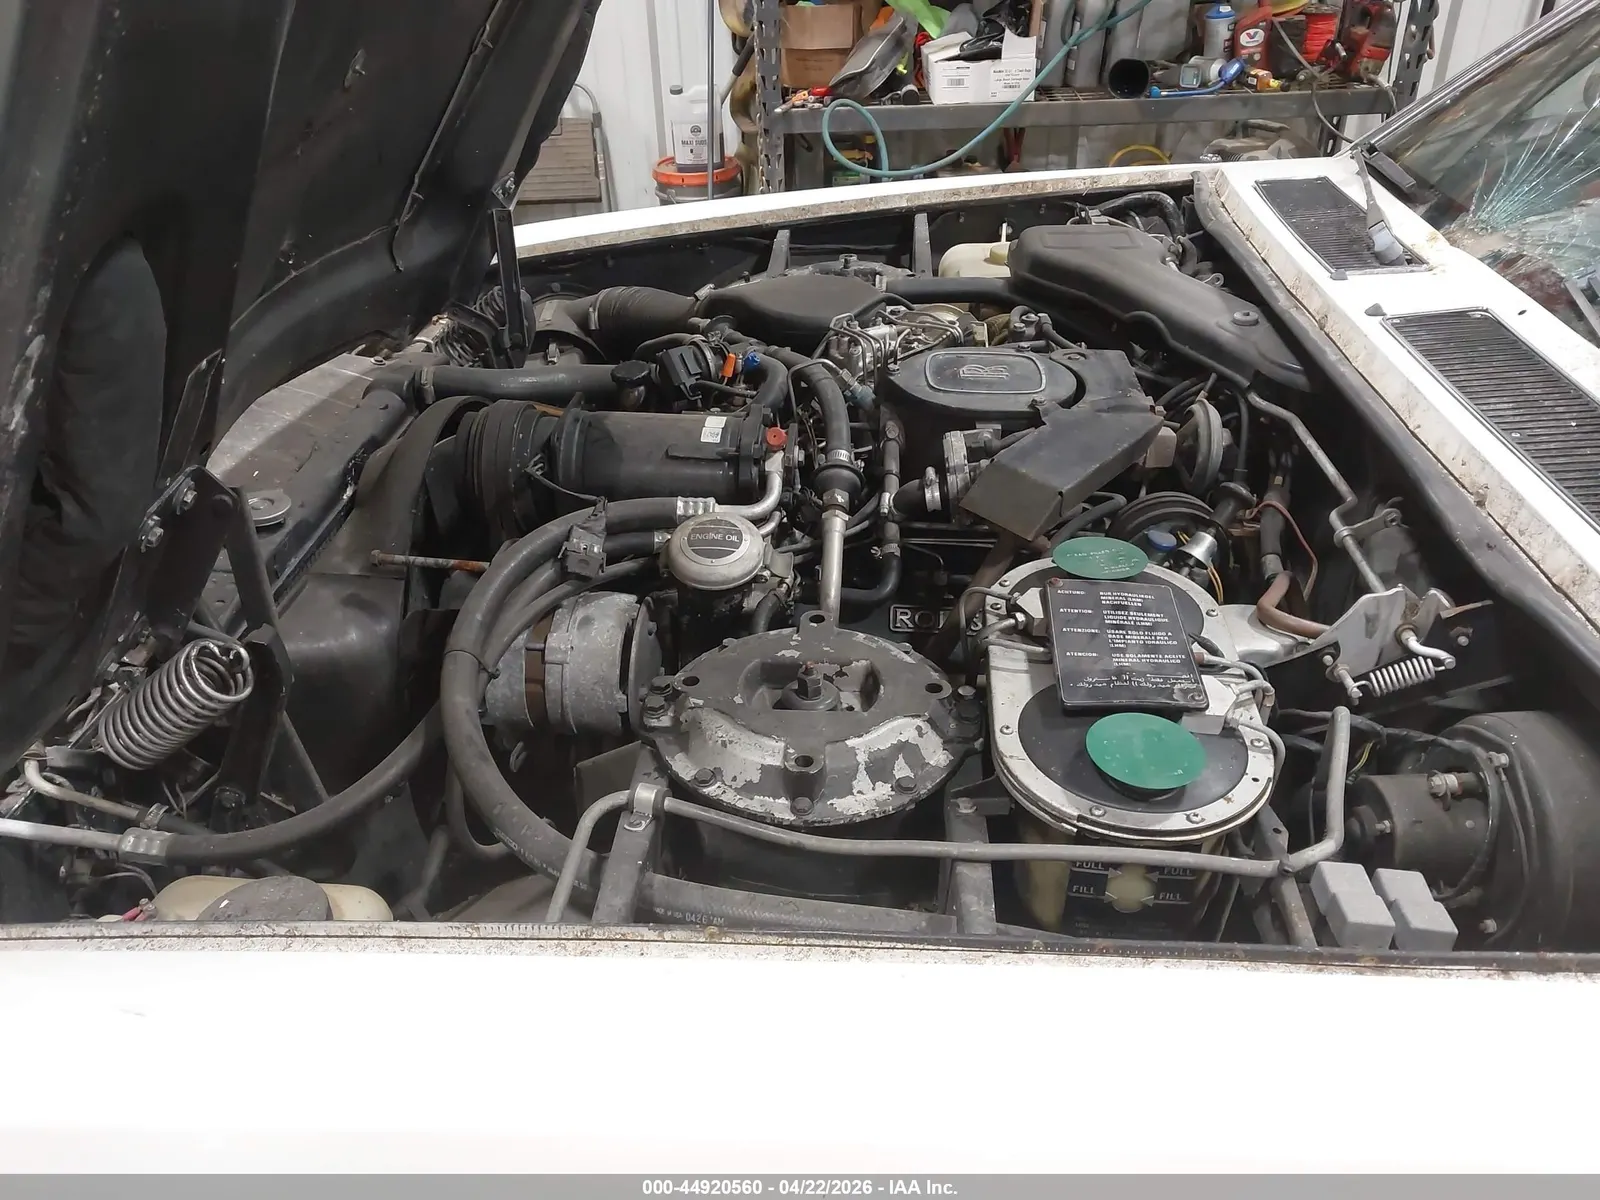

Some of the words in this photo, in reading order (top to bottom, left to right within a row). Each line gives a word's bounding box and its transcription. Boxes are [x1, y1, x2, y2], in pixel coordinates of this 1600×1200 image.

[1076, 861, 1104, 870] FULL
[1164, 867, 1192, 876] FULL
[1072, 885, 1094, 894] FILL
